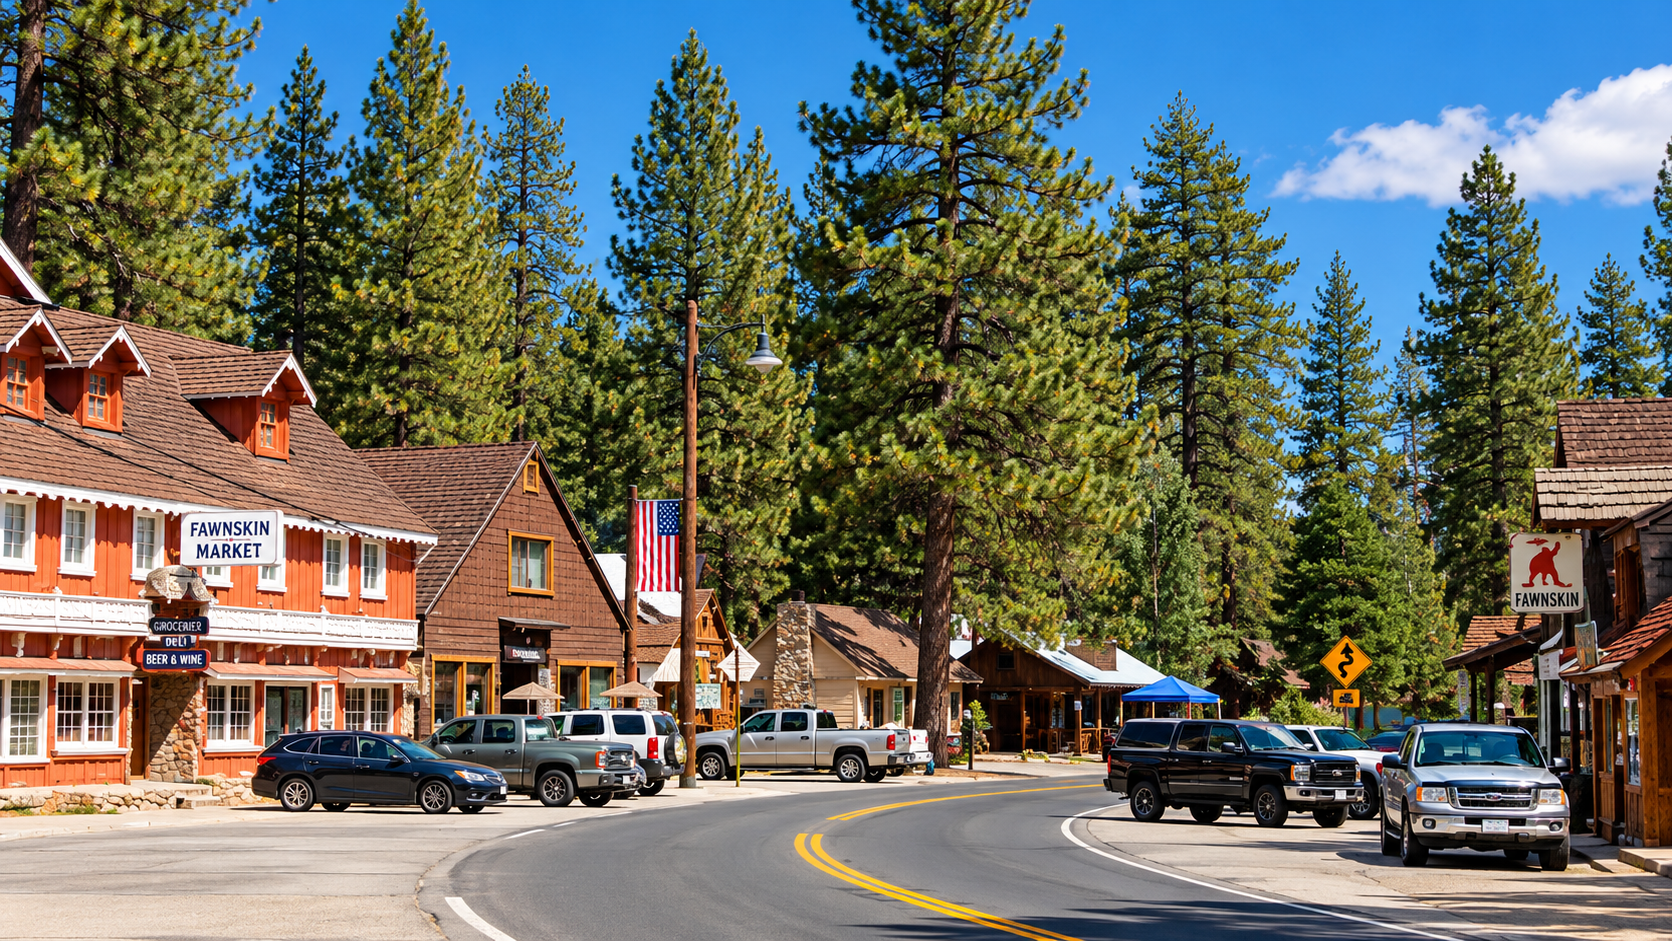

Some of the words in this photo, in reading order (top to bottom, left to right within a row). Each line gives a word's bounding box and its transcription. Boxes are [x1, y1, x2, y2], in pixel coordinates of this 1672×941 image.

[190, 520, 270, 537] FAWNSKIN
[196, 543, 262, 559] MARKET
[1515, 592, 1579, 607] FAWNSKIN
[146, 654, 168, 665] BEER
[171, 655, 177, 665] &
[180, 654, 203, 665] WINE
